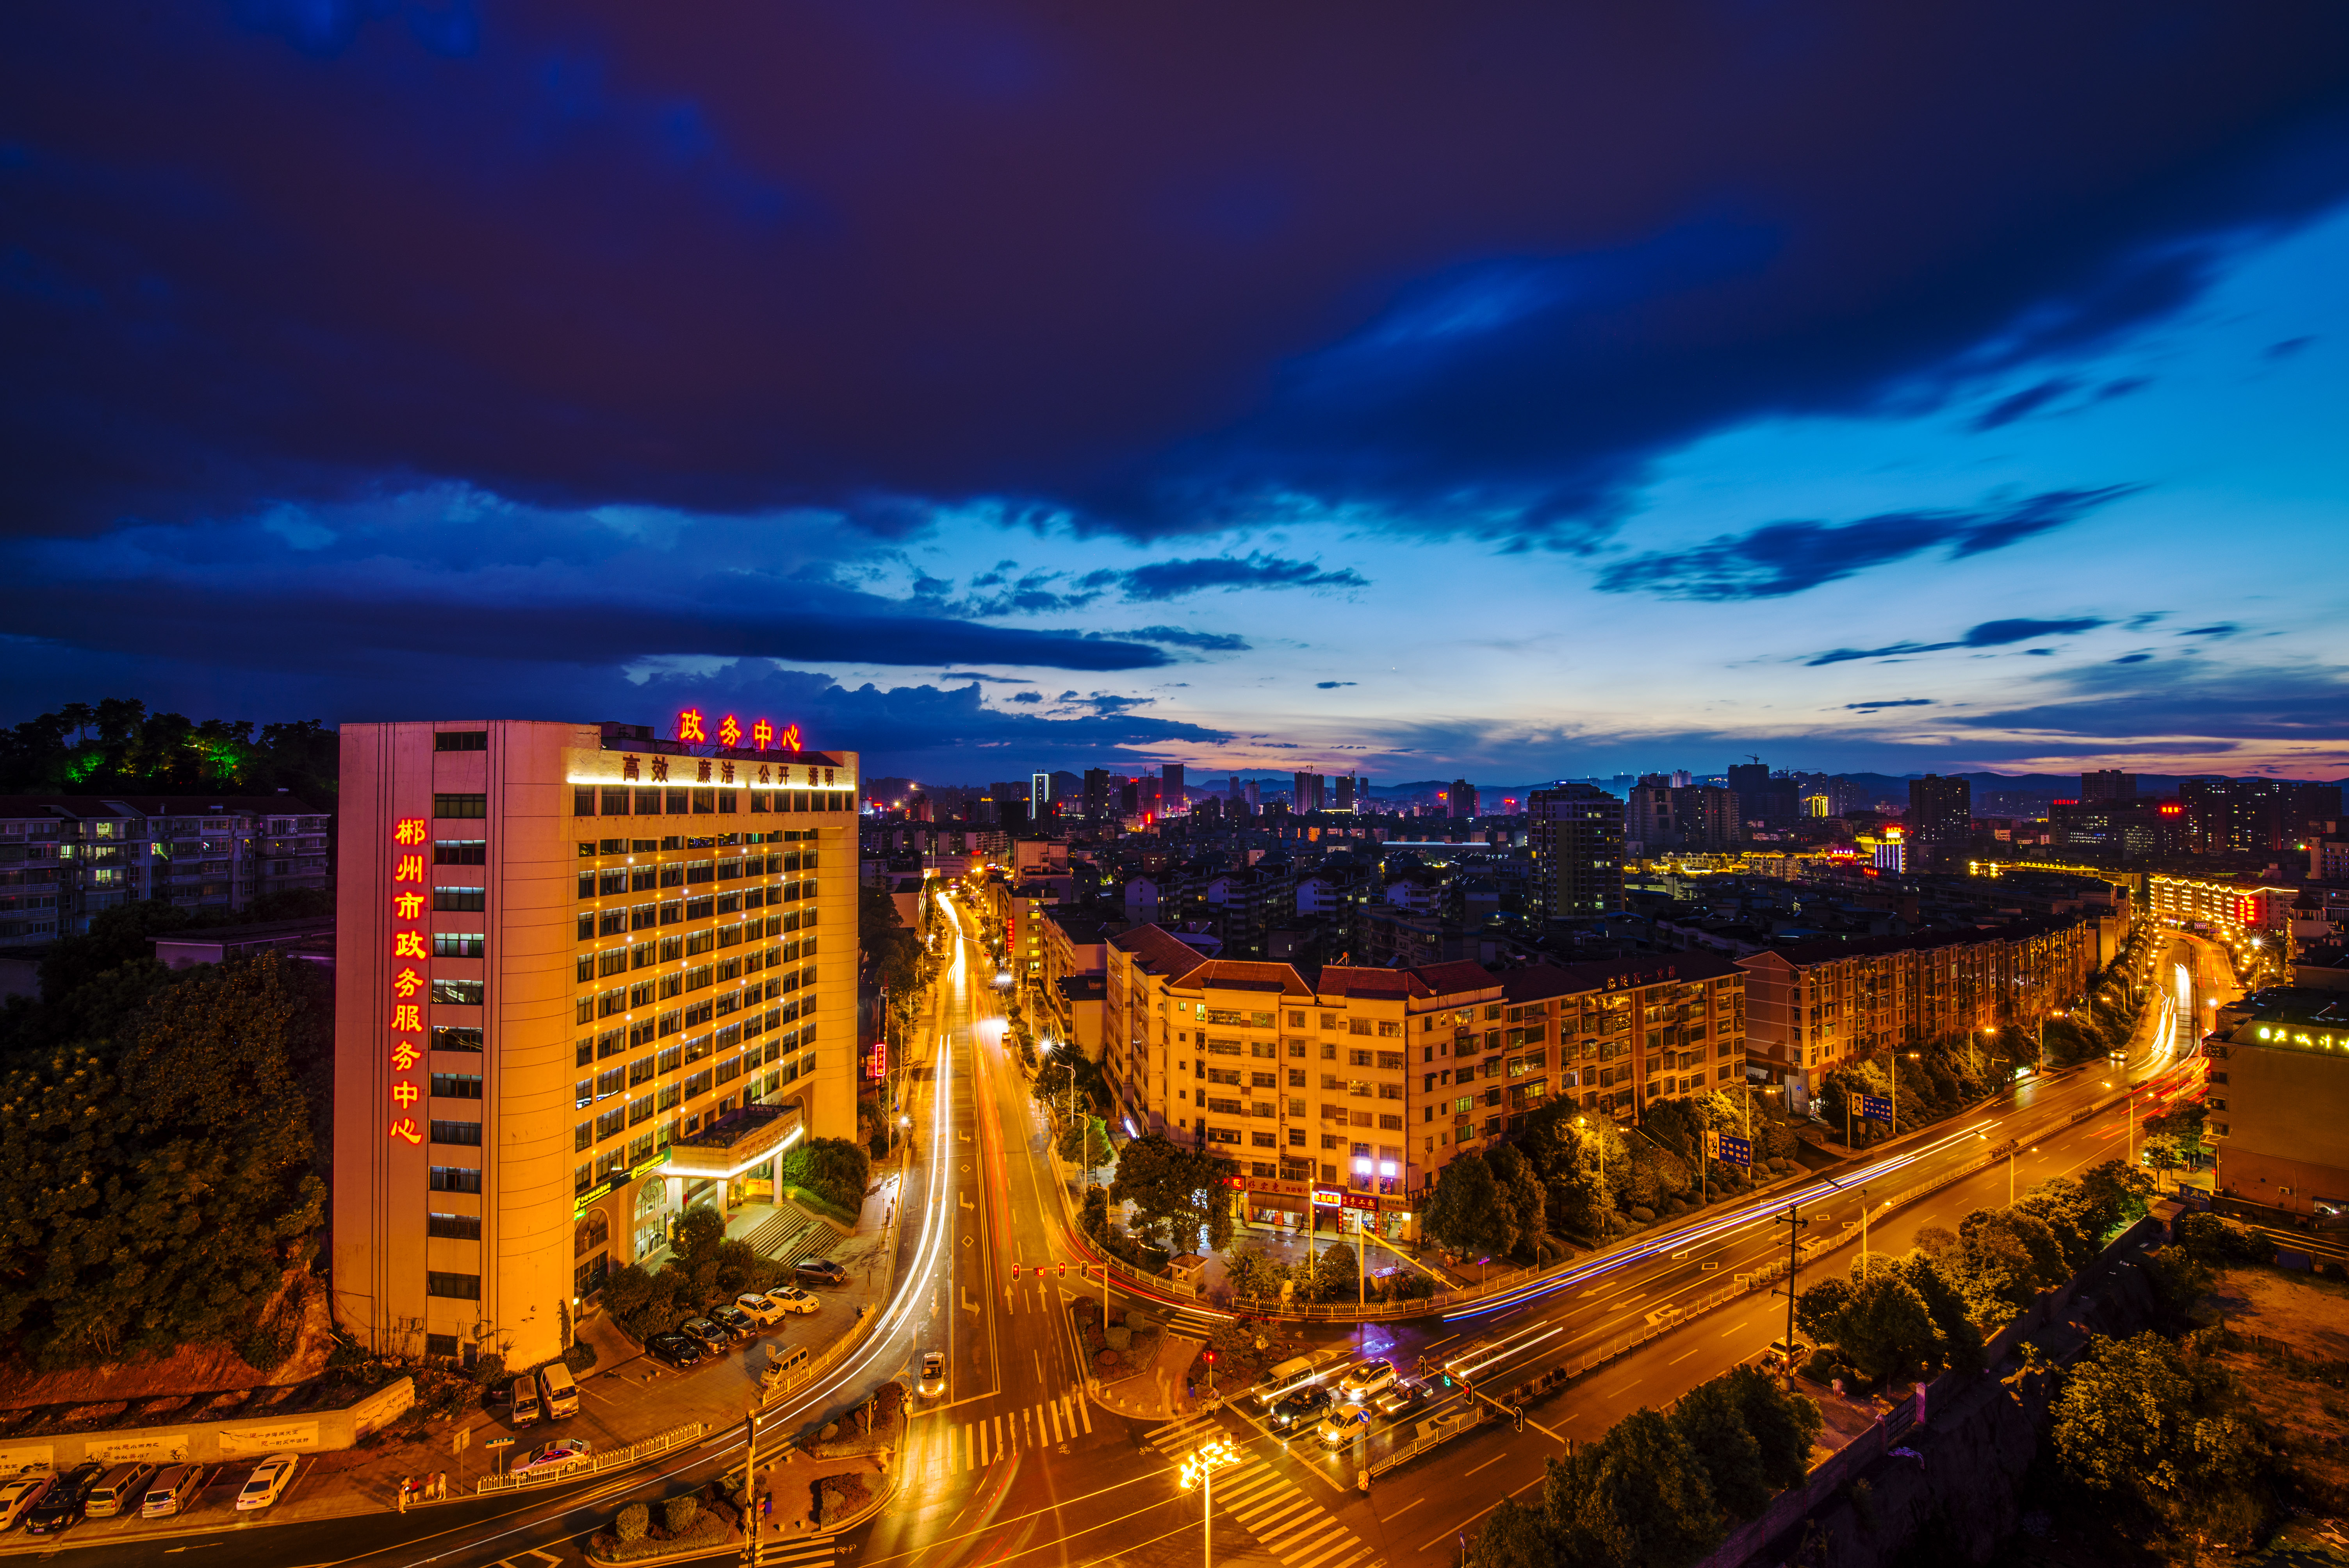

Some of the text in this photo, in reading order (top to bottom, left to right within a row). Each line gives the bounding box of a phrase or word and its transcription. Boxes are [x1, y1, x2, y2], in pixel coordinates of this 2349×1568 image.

[681, 709, 801, 751] 政务中心
[622, 754, 834, 787] 高效 廉洁 公开 透明
[391, 819, 426, 1144] 郴州市政务服务中心
[1721, 1141, 1748, 1152] 关爱生命
[1721, 1149, 1748, 1160] 文明出行
[1350, 1197, 1374, 1207] 手工面
[249, 1430, 298, 1438] 退一步海阔天空
[107, 1442, 160, 1451] 勿以恶小而为之
[261, 1438, 309, 1447] 忍一时风平浪静
